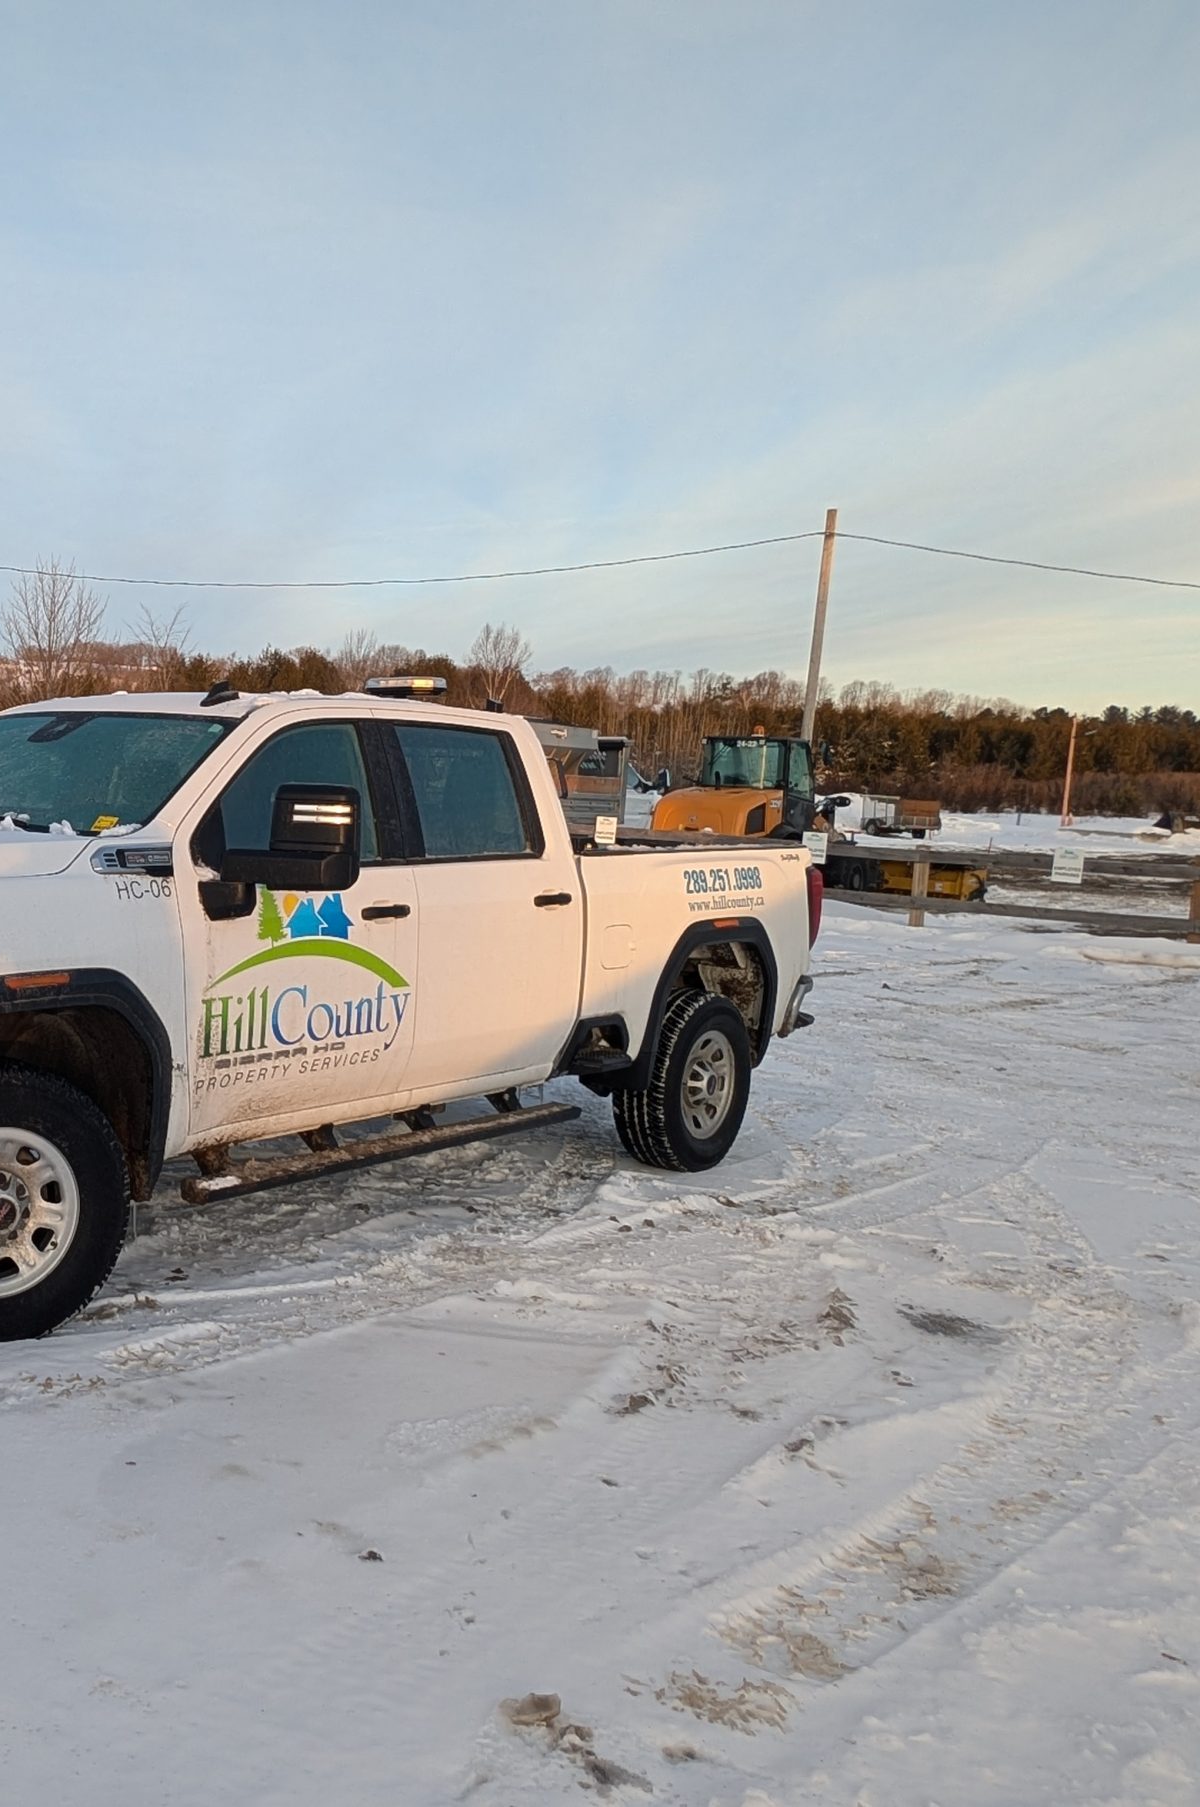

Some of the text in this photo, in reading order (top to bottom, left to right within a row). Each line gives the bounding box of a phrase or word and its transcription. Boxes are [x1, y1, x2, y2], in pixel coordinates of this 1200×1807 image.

[115, 879, 172, 900] HC-06
[683, 866, 762, 894] 289.251.0998
[688, 895, 765, 912] www.hillcounty.ca
[199, 981, 411, 1059] HillCounty
[313, 1041, 346, 1054] HD
[195, 1048, 380, 1095] PROPERTY SERVICES
